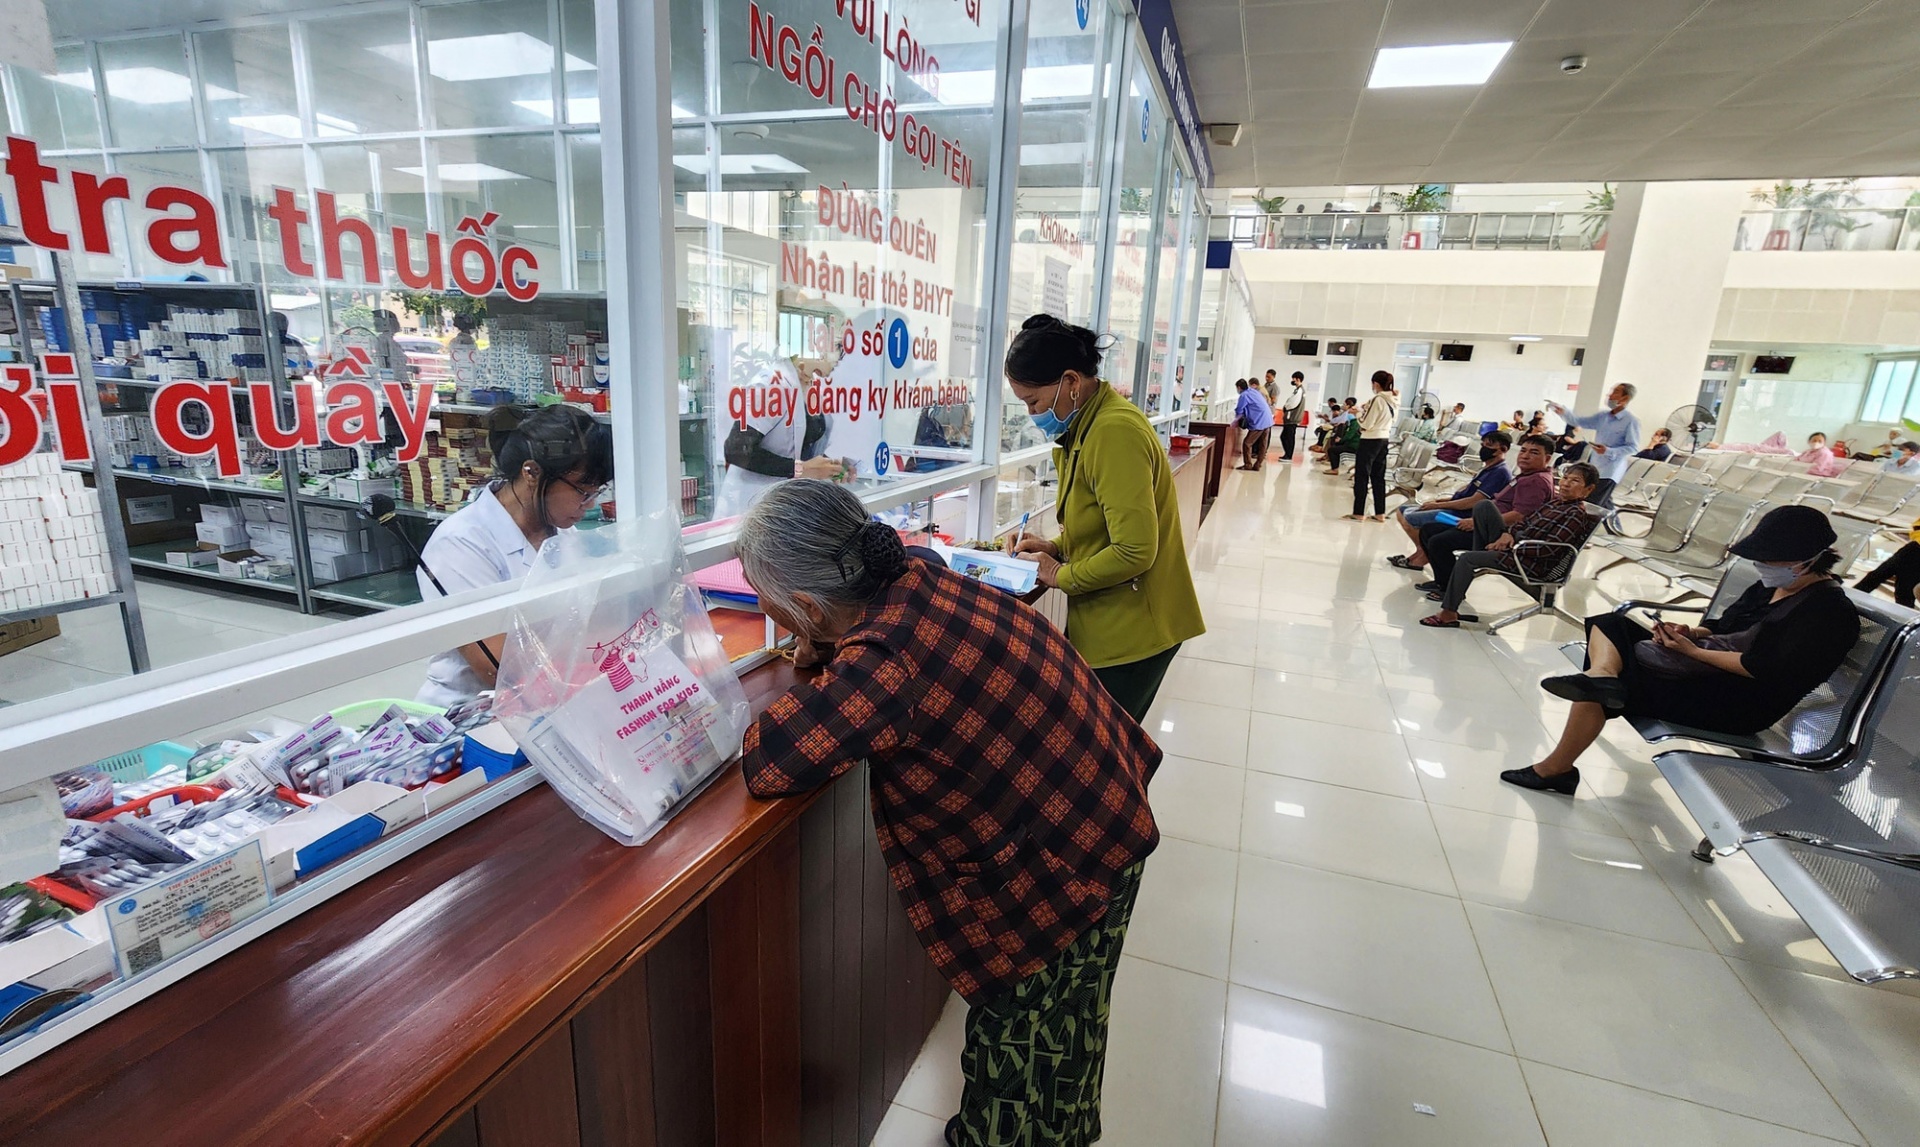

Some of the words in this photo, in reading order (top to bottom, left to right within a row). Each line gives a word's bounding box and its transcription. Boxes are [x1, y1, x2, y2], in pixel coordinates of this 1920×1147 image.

[883, 10, 940, 98] LÒNG
[749, 2, 834, 106] NGỒI
[843, 72, 897, 142] CHỜ
[902, 113, 937, 171] GỌI
[941, 138, 973, 190] TÊN
[6, 135, 228, 269] tra
[269, 185, 540, 303] thuốc
[818, 180, 883, 245] ĐỪNG
[889, 215, 937, 264] QUÊN
[781, 241, 845, 299] Nhận
[852, 261, 876, 307] lại
[881, 271, 908, 309] thẻ
[913, 278, 953, 317] BHYT
[843, 319, 855, 354] ô
[861, 319, 885, 356] số
[912, 326, 938, 362] của
[152, 346, 438, 478] quầy
[728, 370, 798, 431] quầy
[807, 378, 862, 421] đăng
[893, 377, 933, 409] khám
[938, 378, 967, 412] bệnh
[874, 447, 889, 470] 15
[620, 690, 654, 715] THANH
[675, 683, 700, 703] KIDS
